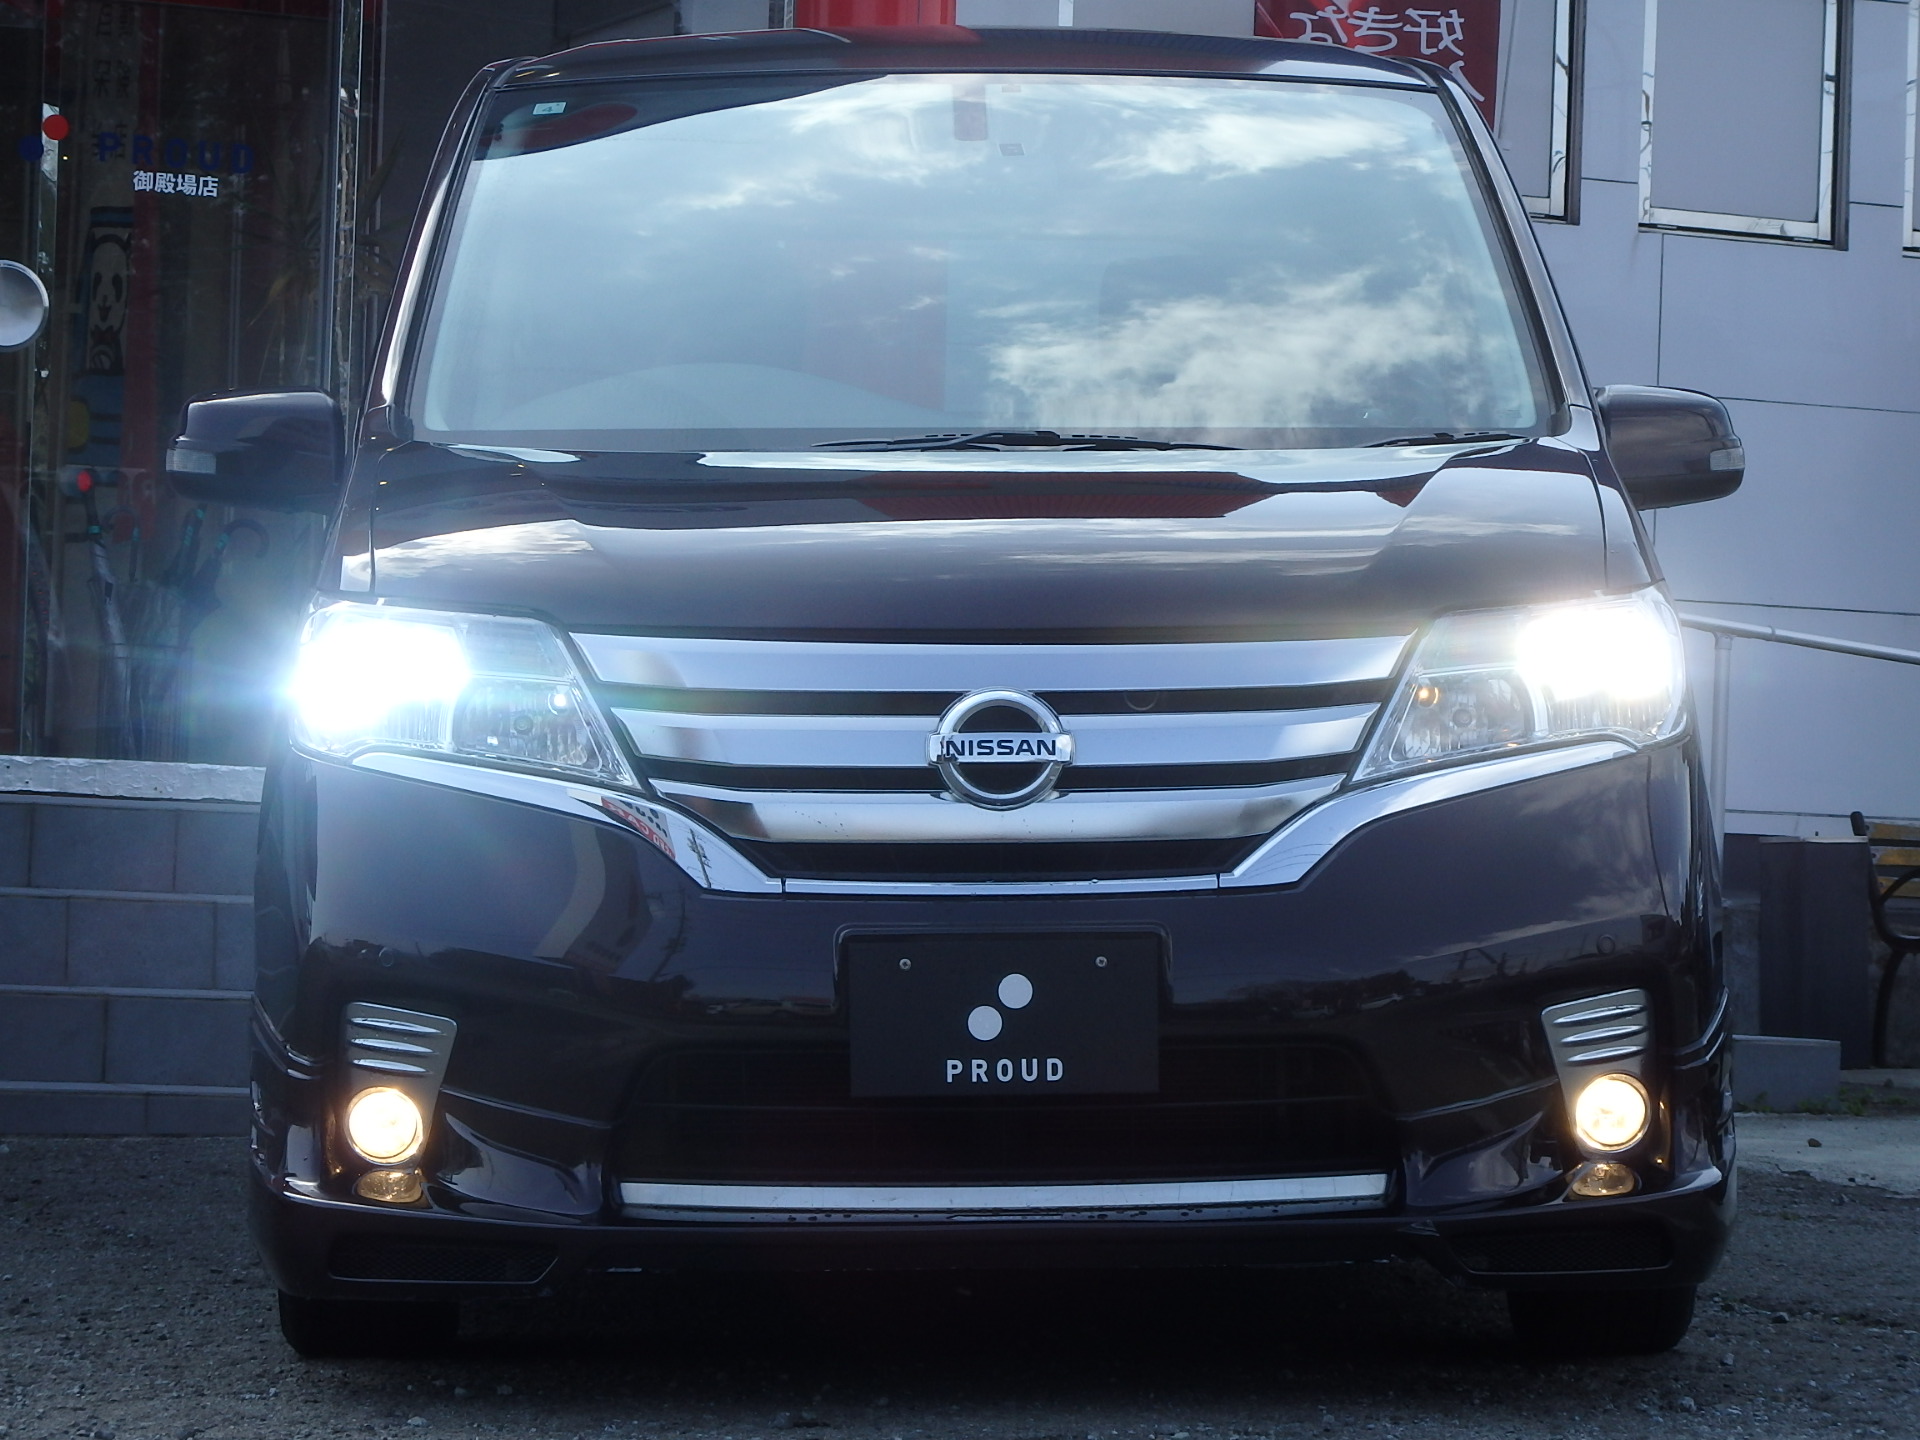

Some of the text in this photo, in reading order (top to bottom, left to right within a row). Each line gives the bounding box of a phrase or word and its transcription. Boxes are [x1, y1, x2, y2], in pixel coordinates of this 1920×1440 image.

[97, 132, 256, 174] PROUD
[132, 170, 219, 198] 御殿場店
[945, 739, 1056, 757] NISSAN
[946, 1058, 1064, 1082] PROUD
